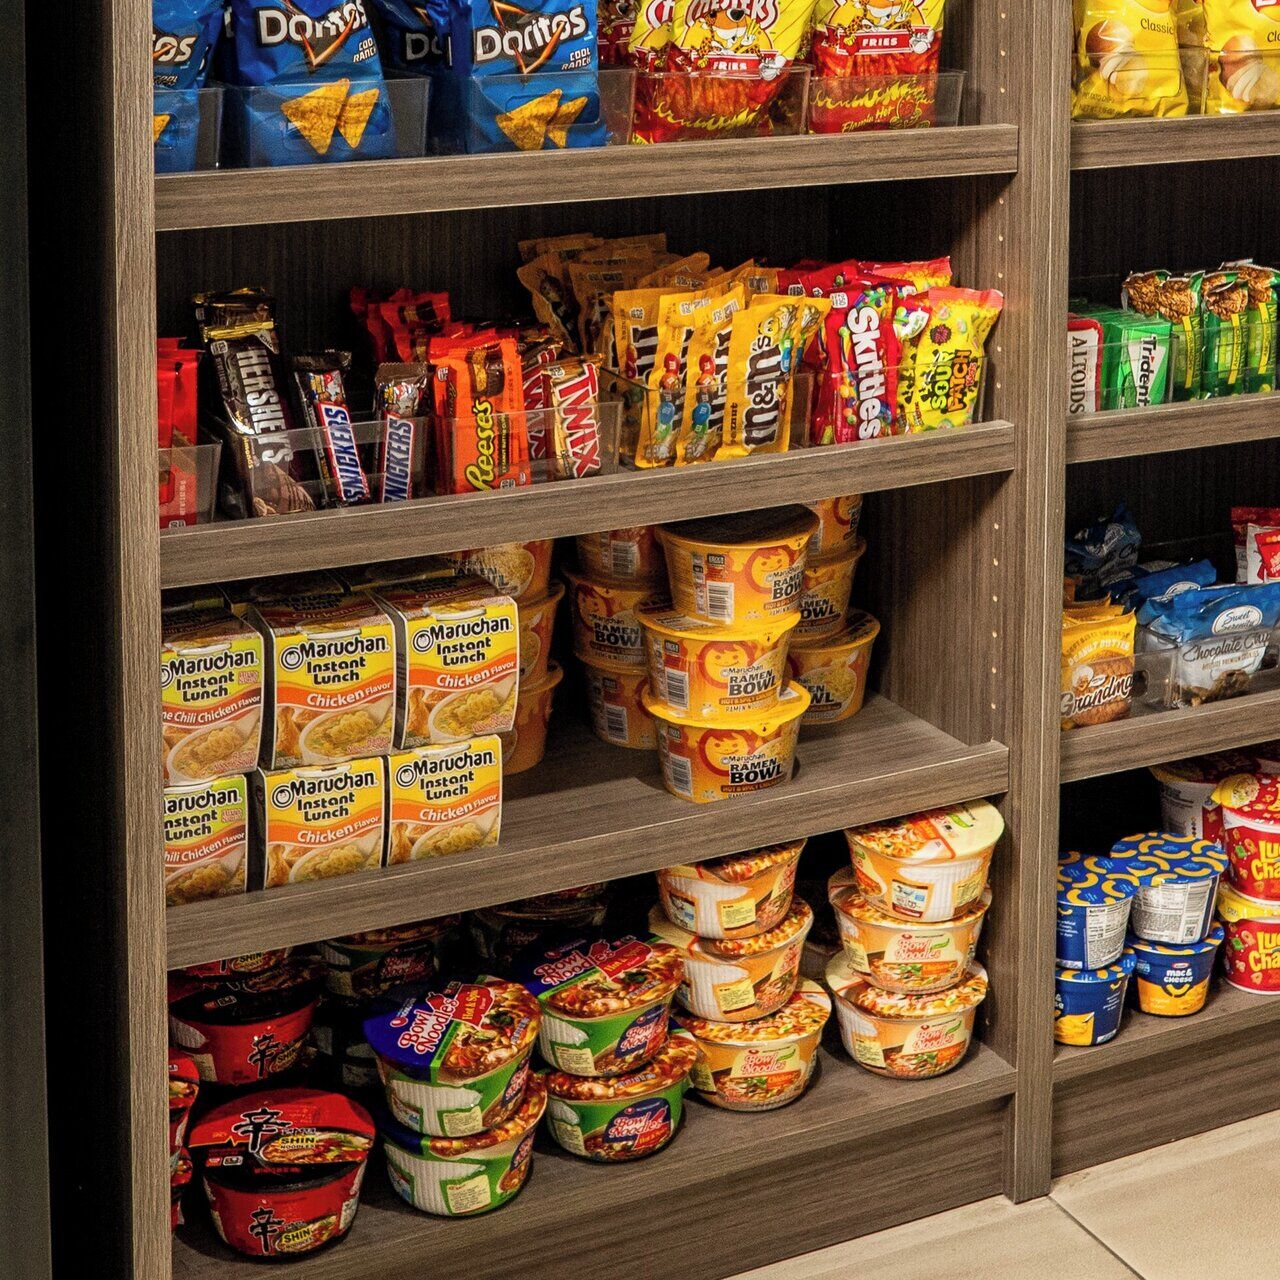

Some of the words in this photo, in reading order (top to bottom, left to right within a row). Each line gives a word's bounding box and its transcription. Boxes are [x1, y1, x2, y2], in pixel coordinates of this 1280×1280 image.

[473, 5, 589, 63] Doritos
[1140, 18, 1174, 34] Classic
[569, 48, 591, 61] COOL
[862, 37, 899, 49] FRIES
[712, 59, 747, 72] FRIES
[847, 306, 881, 440] Skittles
[947, 349, 973, 414] PATCH
[1070, 336, 1088, 414] ALTOIDS
[1135, 333, 1156, 406] Trident
[236, 349, 293, 464] HERSHEY'S
[557, 362, 601, 478] TWIX
[323, 405, 370, 504] SNICKERS
[429, 615, 513, 641] Maruchan
[299, 634, 390, 660] Maruchan
[436, 637, 492, 655] Instant
[442, 650, 486, 667] Lunch
[169, 650, 258, 675] Maruchan
[306, 656, 366, 674] Instant
[436, 667, 490, 687] Chicken
[491, 660, 515, 676] Flavor
[176, 671, 235, 691] Instant
[313, 670, 360, 686] Lunch
[728, 678, 779, 697] BOWL
[182, 684, 229, 703] Lunch
[306, 688, 364, 708] Chicken
[365, 681, 391, 696] Flavor
[198, 699, 238, 723] Chicken
[238, 695, 261, 709] Flavor
[413, 750, 495, 776] Maruchan
[729, 765, 783, 785] BOWL
[730, 758, 778, 773] RAMEN
[290, 770, 377, 797] Maruchan
[419, 771, 475, 790] Instant
[425, 783, 469, 801] Lunch
[297, 793, 355, 811] Instant
[304, 805, 349, 822] Lunch
[419, 801, 473, 821] Chicken
[473, 792, 498, 807] Flavor
[297, 823, 353, 845] Chicken
[354, 815, 380, 831] Flavor
[235, 1107, 289, 1153] 辛
[281, 1136, 316, 1145] SHIN
[249, 1207, 285, 1253] 辛
